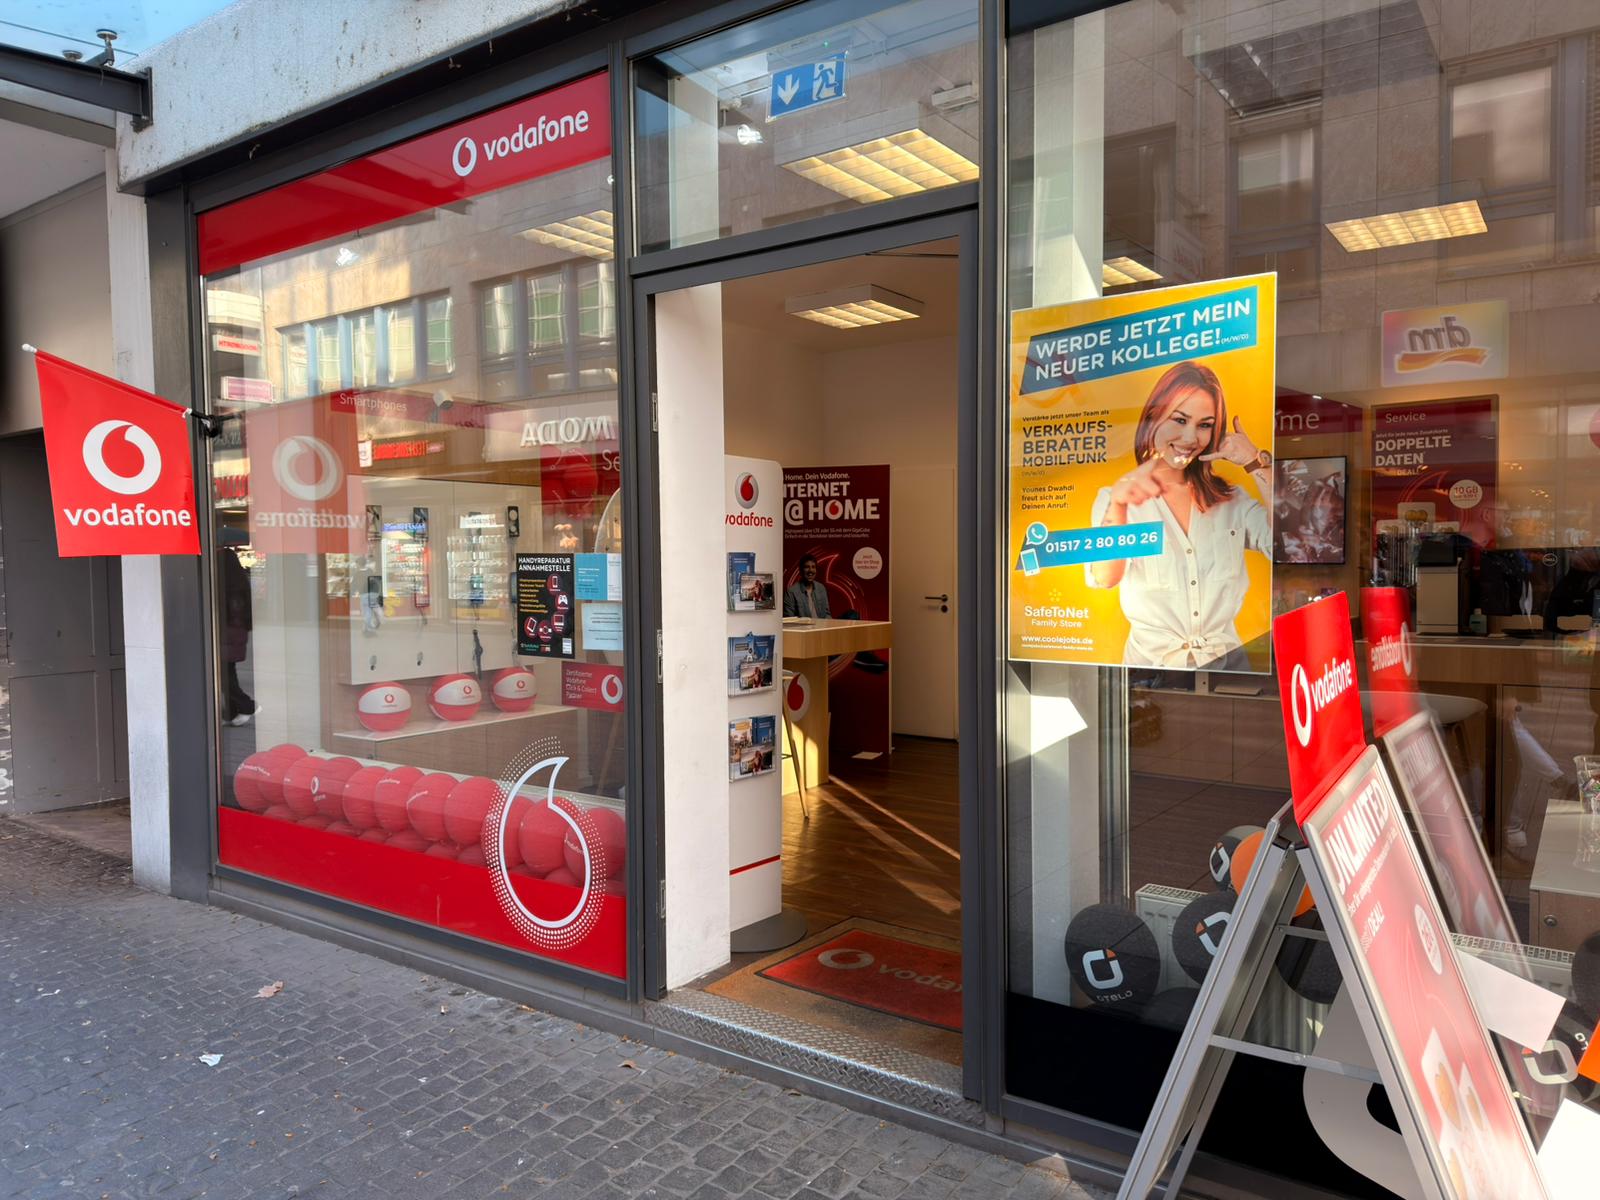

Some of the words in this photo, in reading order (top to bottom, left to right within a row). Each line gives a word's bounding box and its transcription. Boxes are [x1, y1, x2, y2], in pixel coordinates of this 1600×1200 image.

[483, 110, 590, 161] vodafone
[1035, 328, 1112, 360] WERDE
[1117, 312, 1186, 343] JETZT
[1192, 297, 1250, 327] MEIN
[1035, 353, 1105, 381] NEUER
[1111, 327, 1222, 366] KOLLEGE!
[339, 392, 408, 412] Smartphones
[1050, 413, 1064, 421] jetzt
[1275, 412, 1321, 432] me
[1385, 411, 1426, 424] Service
[1022, 420, 1113, 438] VERKAUFS-
[1023, 436, 1107, 455] BERATER
[1375, 435, 1452, 452] DOPPELTE
[1022, 451, 1107, 468] MOBILFUNK
[1375, 452, 1424, 467] DATEN
[820, 472, 851, 480] Vodafone.
[783, 481, 851, 498] TERNET
[63, 502, 192, 527] vodafone
[808, 498, 880, 520] HOME
[1045, 533, 1081, 553] 01517
[1084, 535, 1092, 550] 2
[1095, 534, 1114, 549] 80
[1117, 532, 1137, 547] 80
[1140, 530, 1158, 545] 26
[1024, 605, 1089, 619] SafeToNet
[1031, 618, 1058, 628] Family
[1059, 619, 1083, 628] Store
[1310, 657, 1353, 712] vodafone
[880, 964, 963, 993] voda
